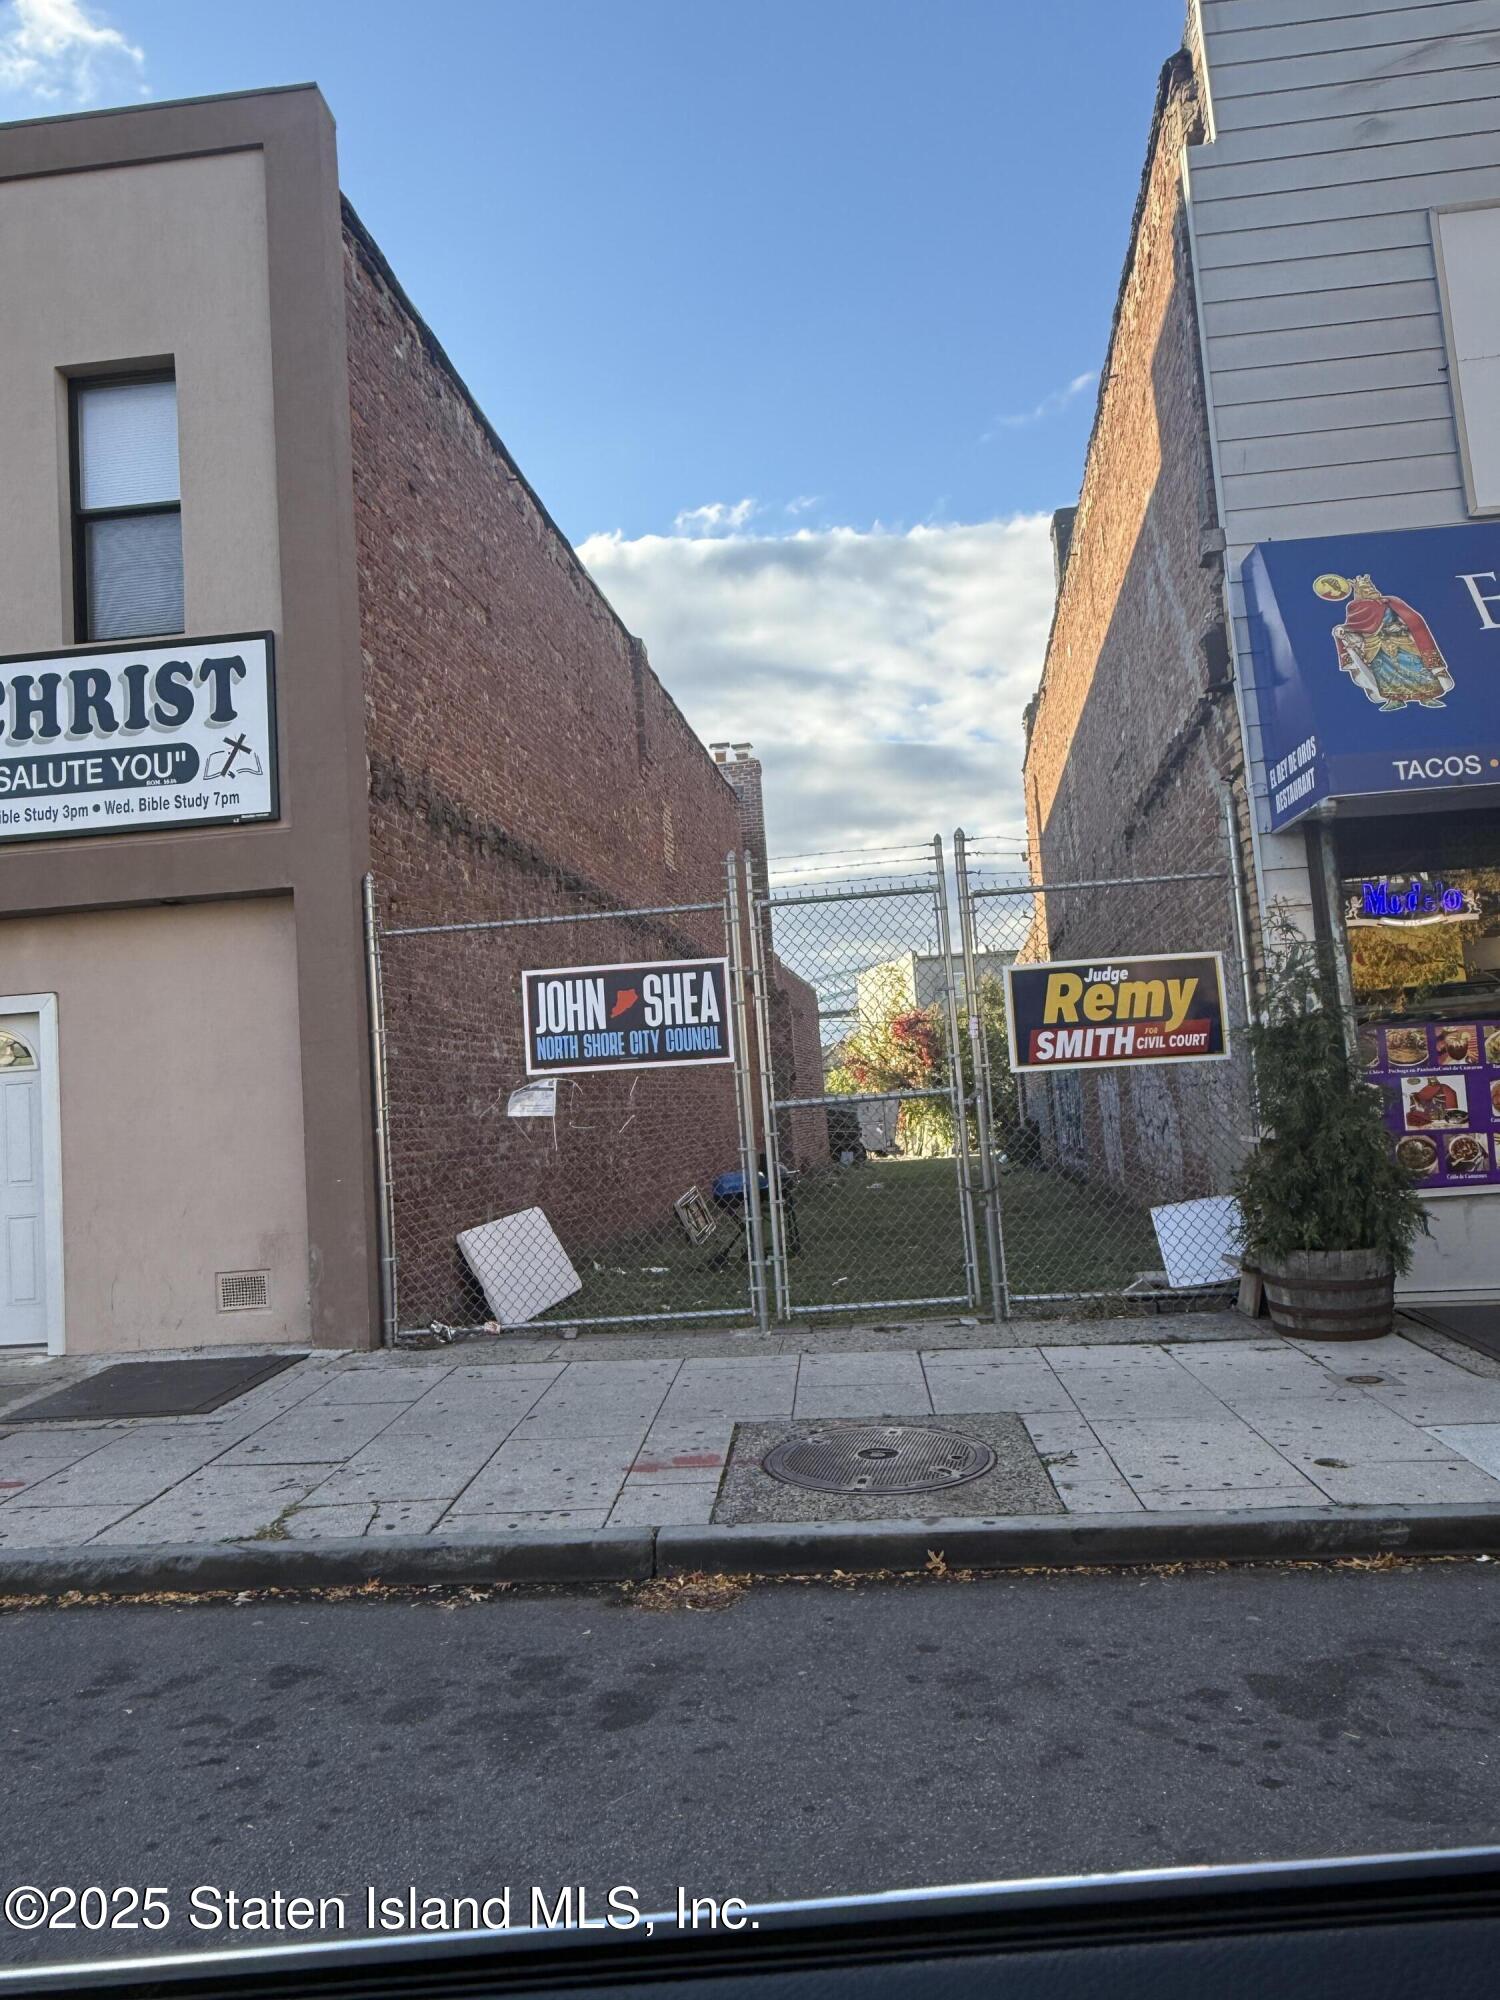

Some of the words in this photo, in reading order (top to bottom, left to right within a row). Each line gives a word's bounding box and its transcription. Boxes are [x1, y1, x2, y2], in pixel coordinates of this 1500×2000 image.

[0, 655, 247, 742] HRIST
[0, 757, 103, 793] SALUTE
[111, 750, 187, 781] YOU"
[1269, 768, 1278, 790] EL
[1276, 757, 1288, 785] REY
[1288, 750, 1298, 775] DE
[1297, 735, 1316, 768] OROS
[1392, 755, 1482, 781] TACOS
[24, 805, 59, 823] Study
[62, 804, 89, 821] 3pm
[104, 799, 134, 815] Wed.
[139, 796, 170, 812] Bible
[174, 793, 209, 810] Study
[213, 792, 240, 808] 7pm
[1275, 766, 1315, 815] RESTAURANT
[1084, 966, 1129, 985] Judge
[536, 978, 607, 1034] JOHN
[642, 971, 721, 1027] SHEA
[1043, 972, 1199, 1032] Remy
[536, 1035, 579, 1061] NORTH
[583, 1031, 625, 1058] SHORE
[629, 1028, 660, 1055] CITY
[665, 1026, 722, 1053] COUNCIL
[1035, 1026, 1135, 1060] SMITH
[1136, 1034, 1166, 1049] CIVIL
[1169, 1033, 1208, 1048] COURT
